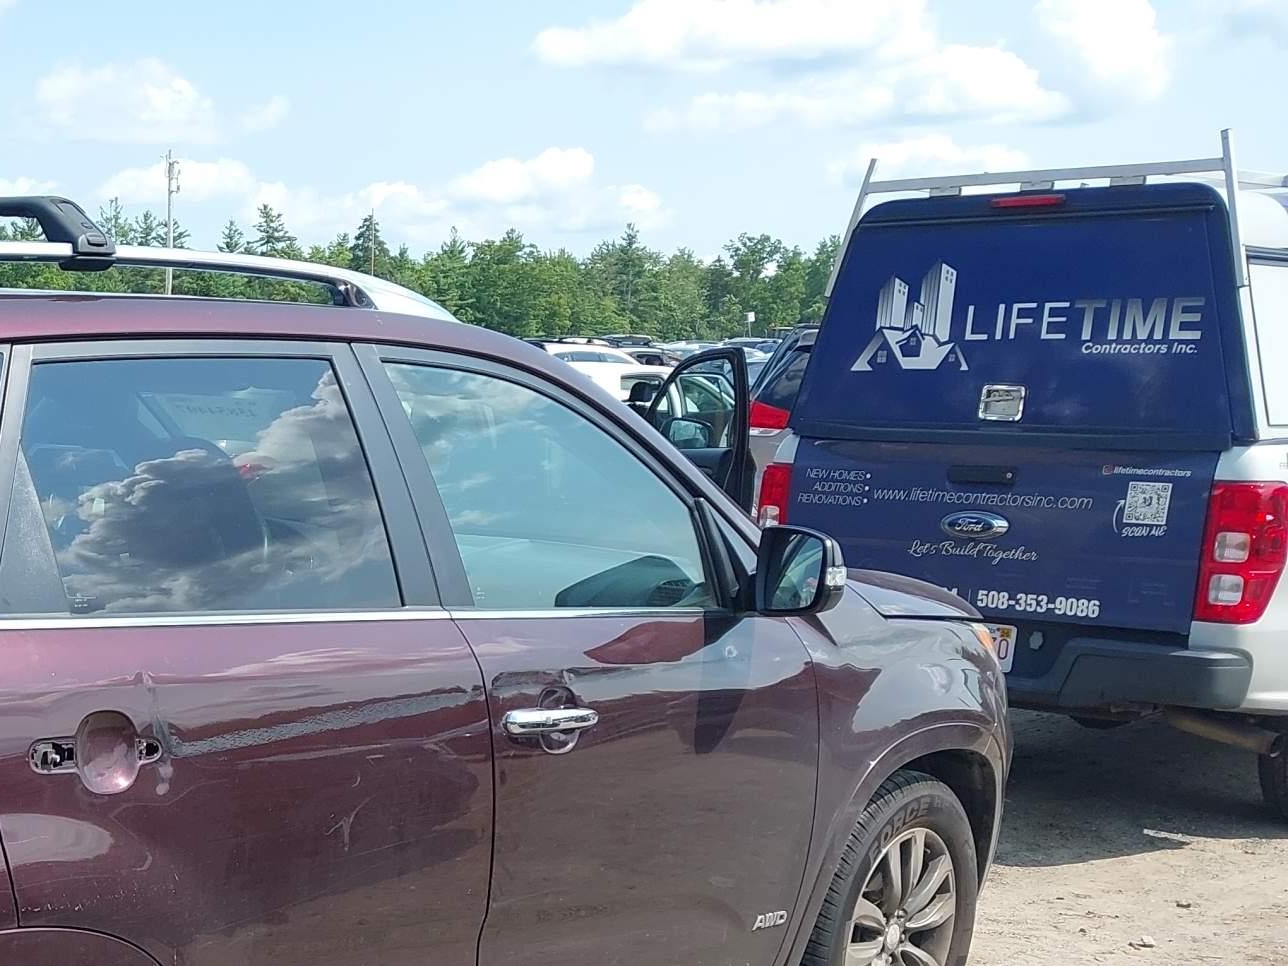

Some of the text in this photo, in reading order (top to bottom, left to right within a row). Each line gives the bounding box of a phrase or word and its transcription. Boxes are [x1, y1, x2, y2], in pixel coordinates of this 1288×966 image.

[964, 297, 1206, 341] LIFETIME
[1080, 341, 1199, 355] Contractors Inc.
[806, 467, 865, 481] NEW HOMES
[1113, 466, 1192, 477] lifetimecontractors
[812, 481, 863, 494] ADDITIONS
[797, 492, 862, 507] RENOVATIONS
[873, 487, 1094, 511] www.lifetimecontractorsinc.com
[954, 518, 985, 533] Ford
[1121, 525, 1167, 537] SCAN ME
[907, 539, 1039, 566] Let's Build Together
[976, 589, 1101, 619] 508-353-9086
[751, 910, 788, 931] AWD
